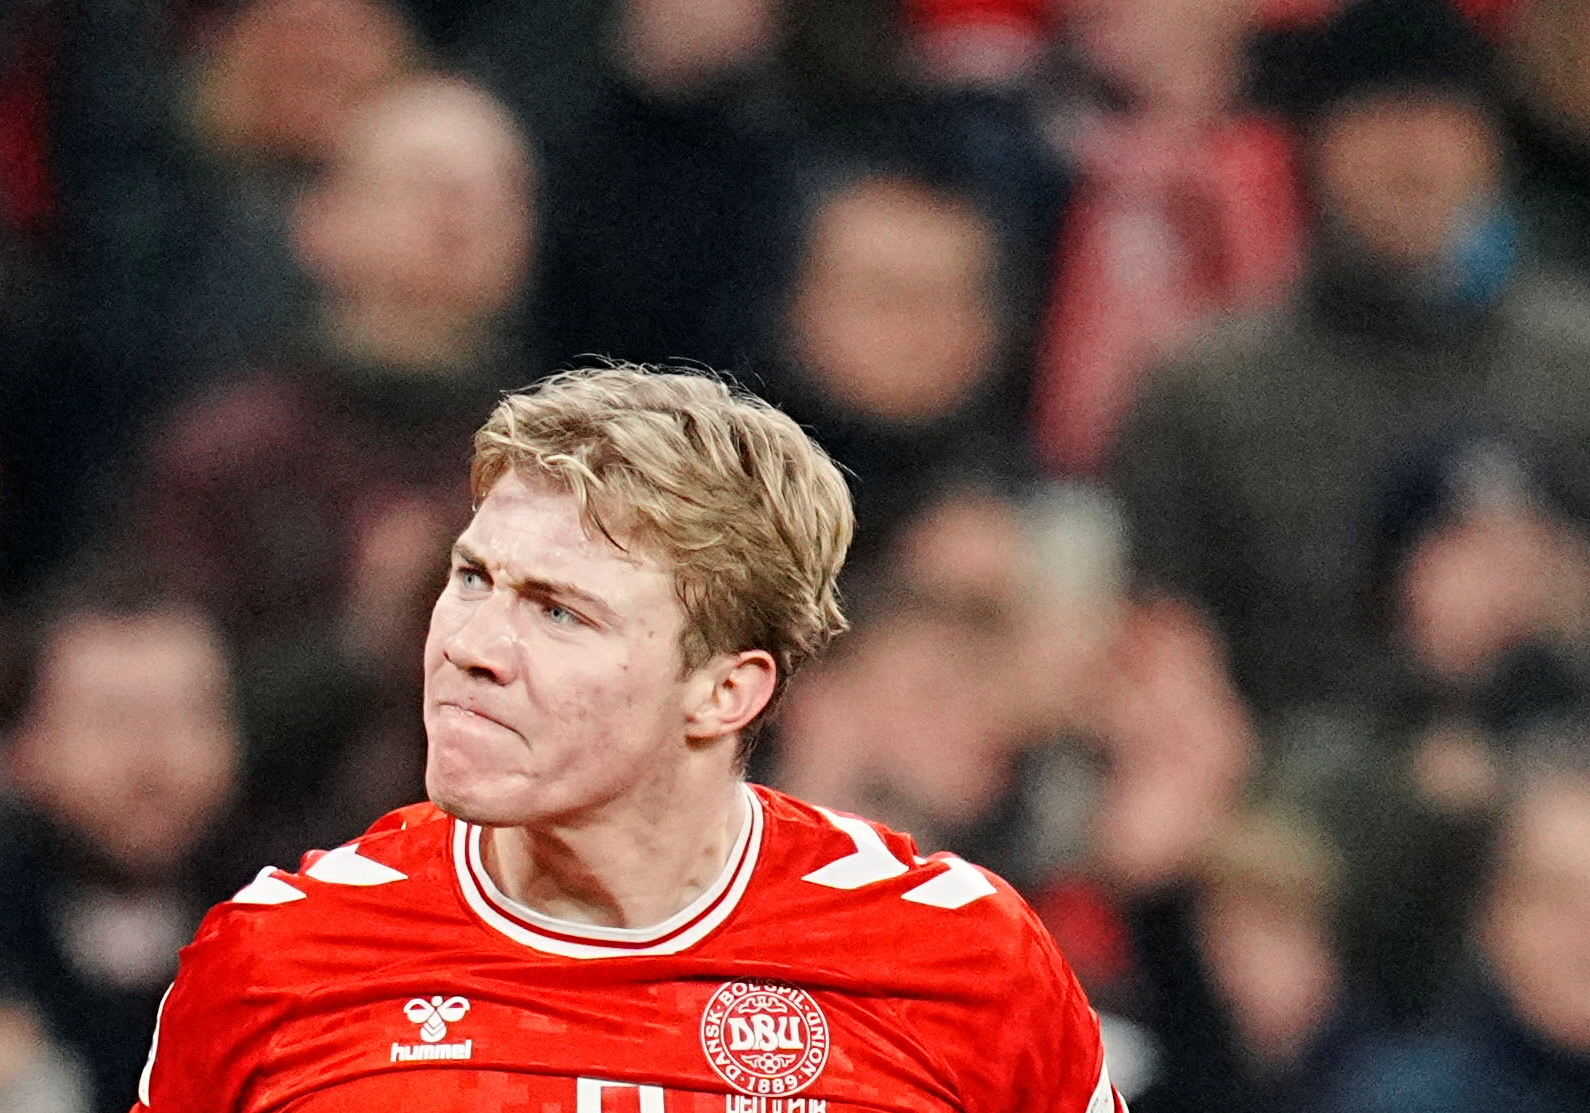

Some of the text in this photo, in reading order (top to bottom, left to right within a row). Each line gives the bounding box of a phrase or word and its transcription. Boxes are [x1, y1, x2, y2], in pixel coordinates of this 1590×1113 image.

[706, 1010, 742, 1081] DANSK
[801, 1012, 825, 1077] UNION
[727, 1013, 804, 1051] DBU
[390, 1039, 472, 1062] hummel
[747, 1077, 798, 1093] 1889
